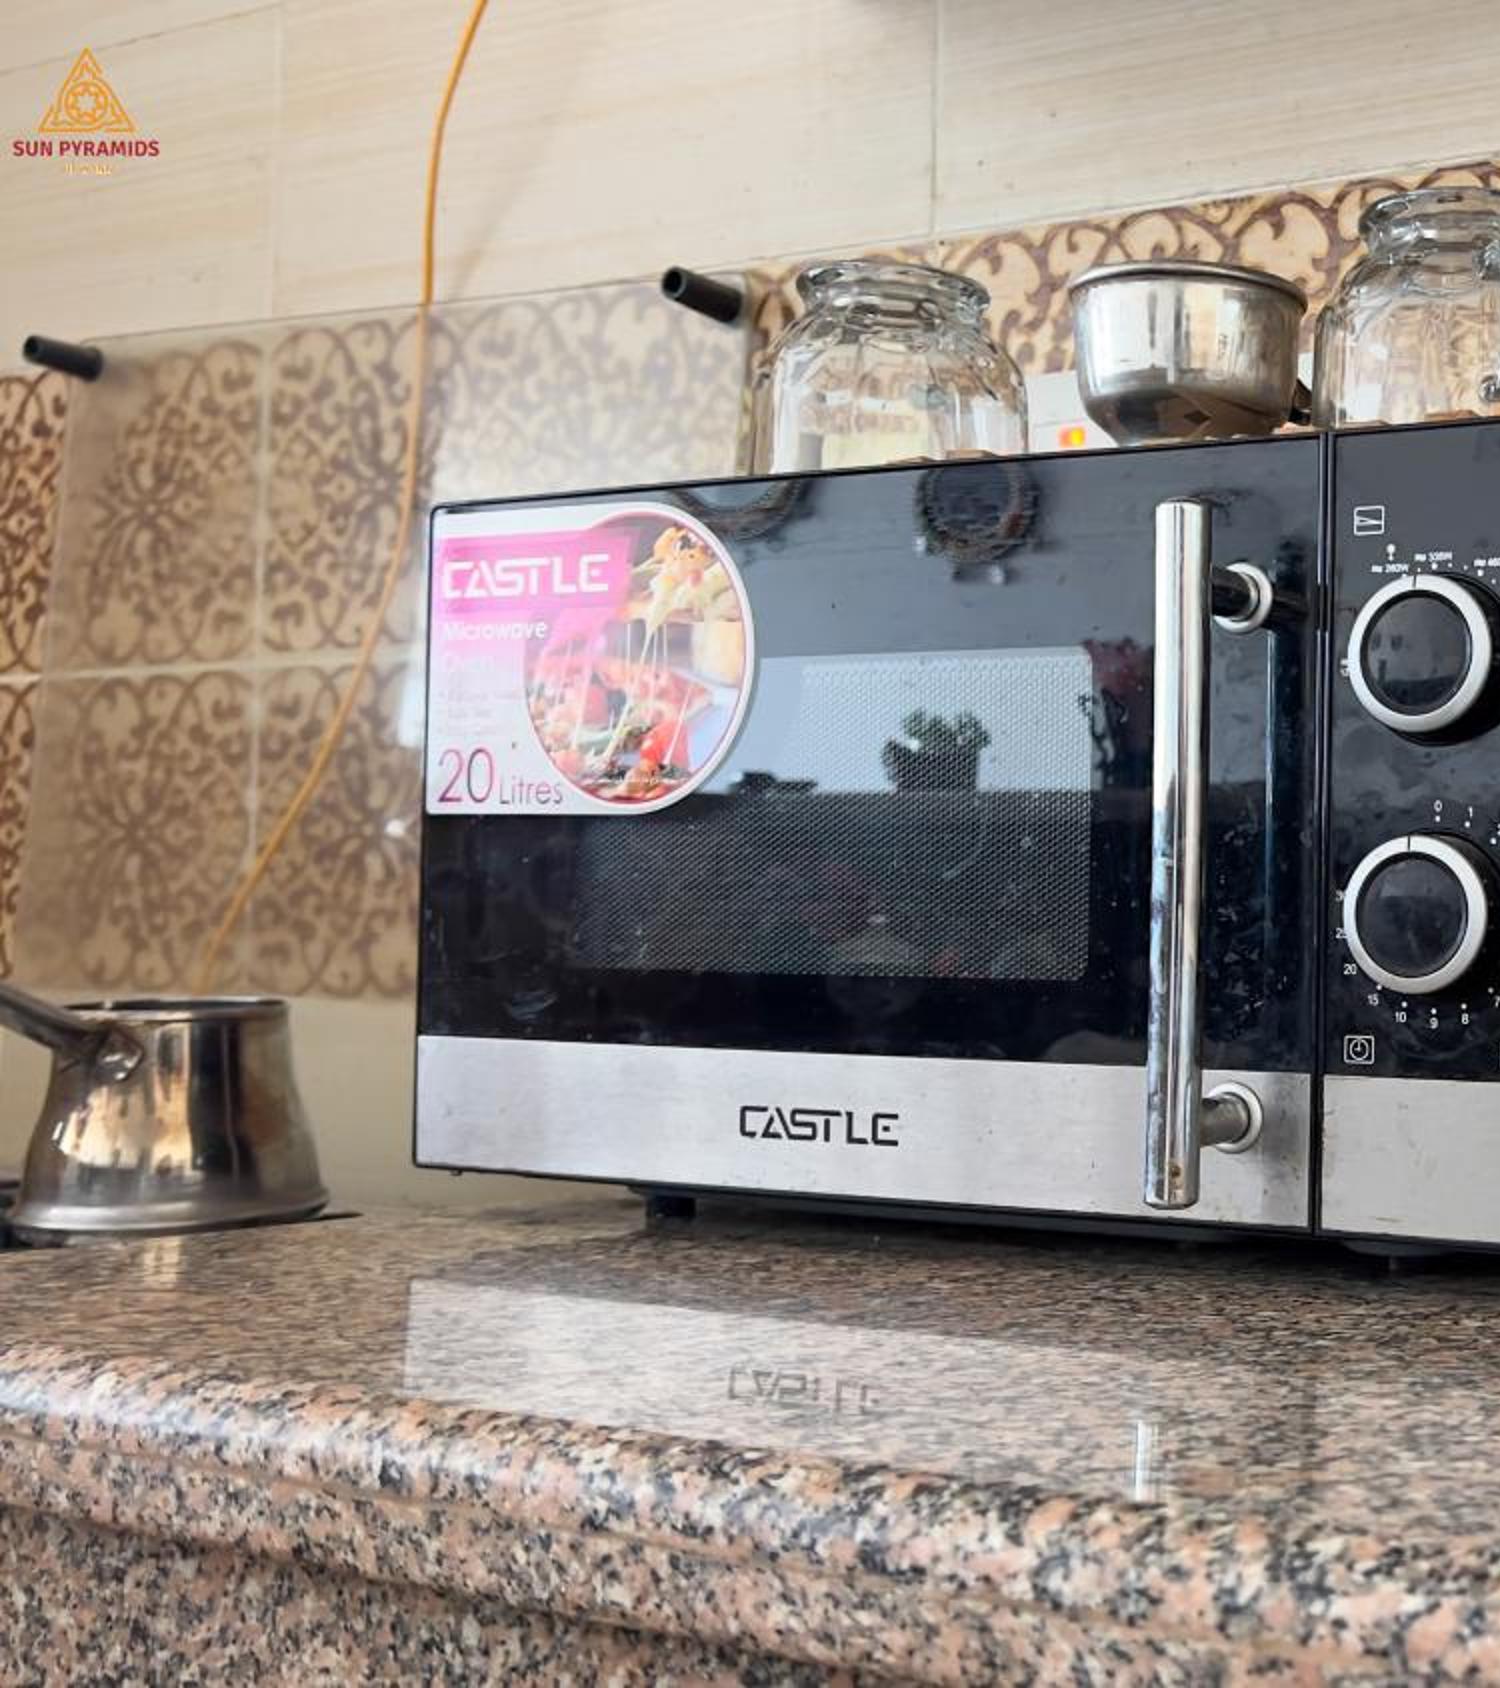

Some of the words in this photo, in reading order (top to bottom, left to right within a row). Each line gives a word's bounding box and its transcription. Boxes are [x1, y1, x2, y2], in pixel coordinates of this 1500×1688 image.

[443, 553, 610, 598] CASTLE
[442, 621, 548, 641] Microwave
[437, 747, 494, 804] 20
[499, 770, 563, 806] Litres
[1433, 800, 1443, 813] 0
[1467, 805, 1474, 819] 1
[1335, 889, 1345, 902] 3
[1343, 963, 1358, 976] 20
[1367, 994, 1379, 1007] 15
[1395, 1011, 1407, 1023] 10
[1429, 1017, 1439, 1030] 9
[1461, 1013, 1470, 1026] 8
[739, 1105, 899, 1147] CASTLE
